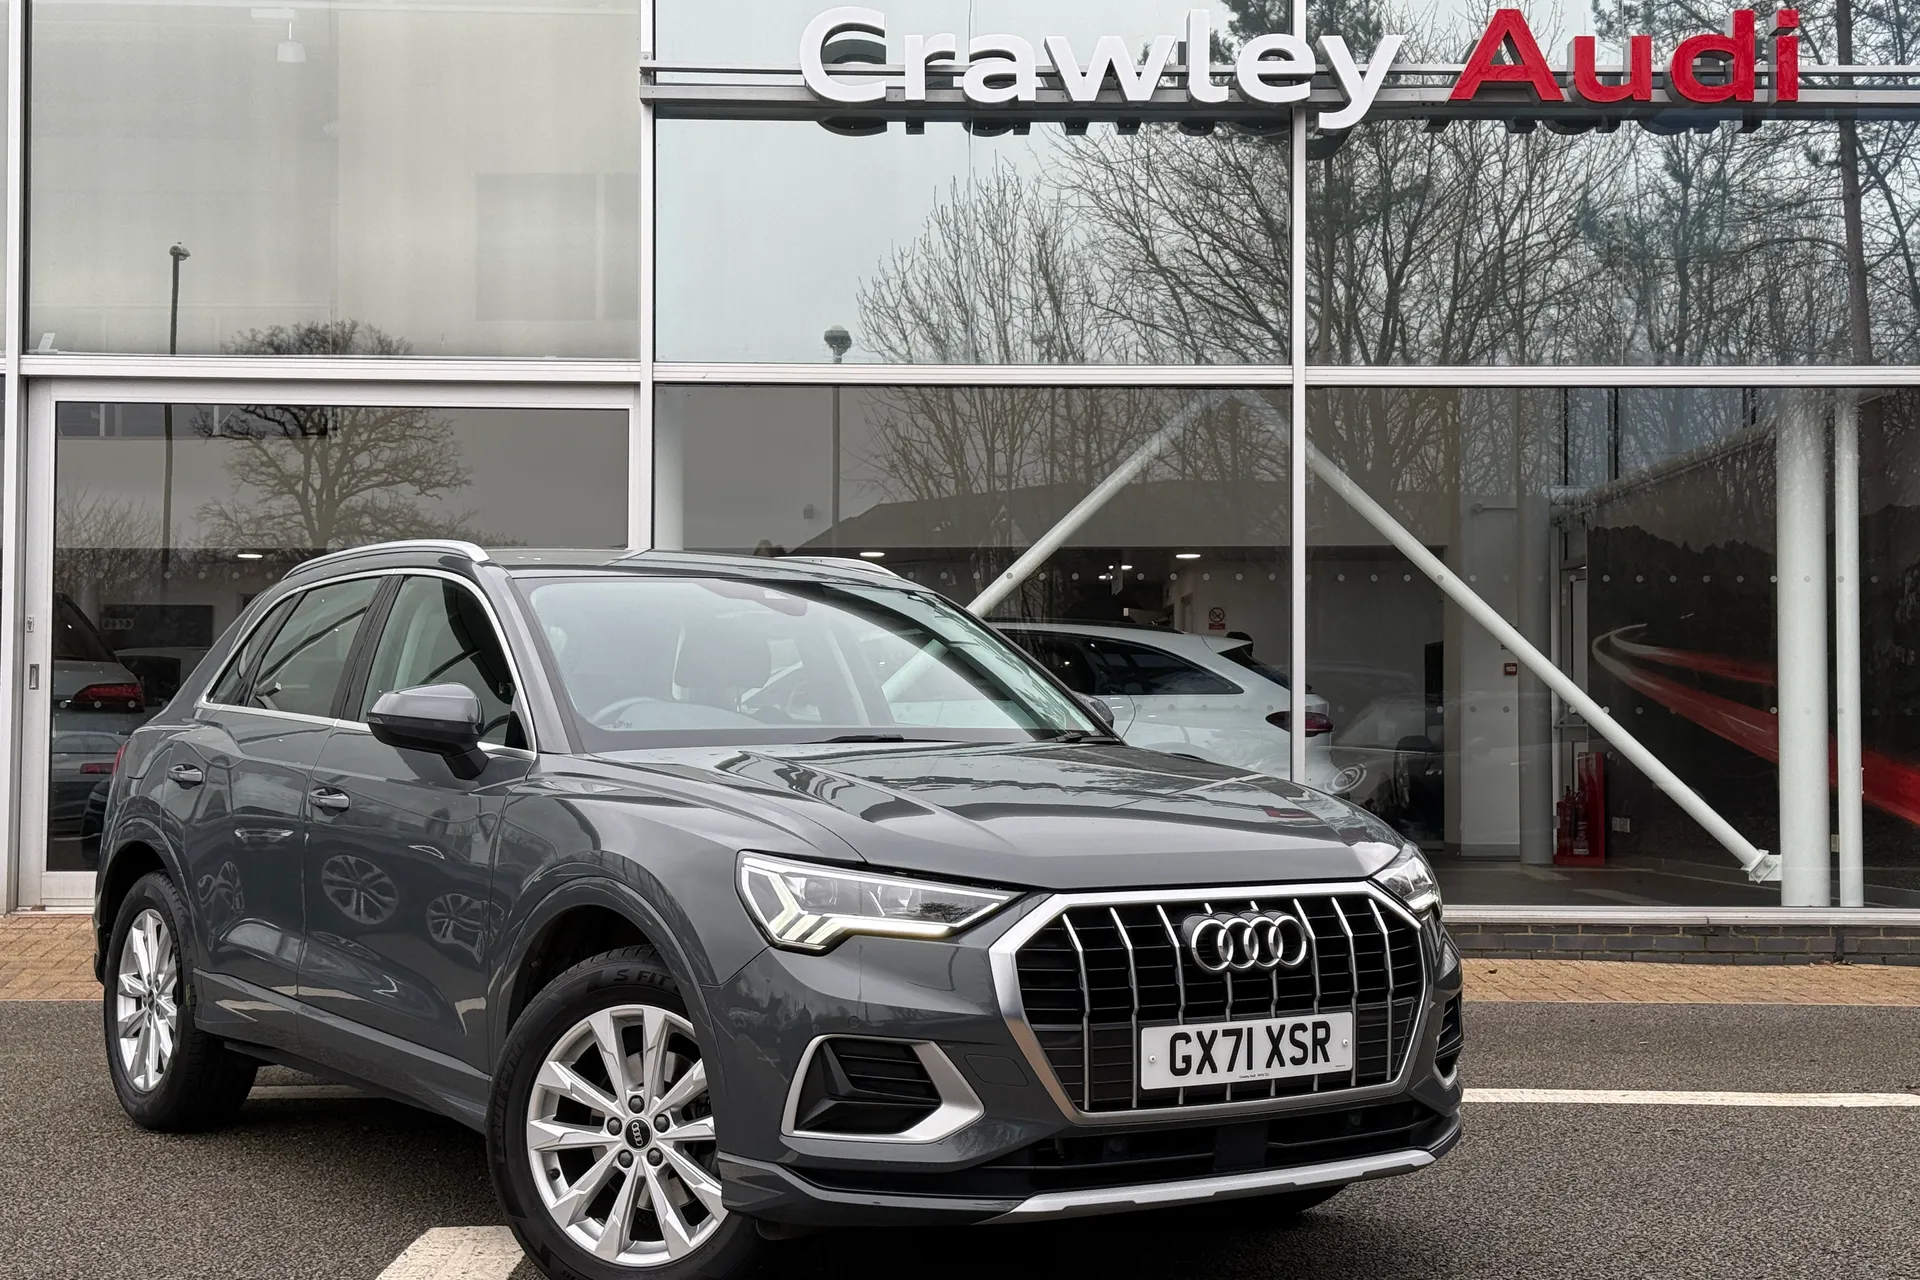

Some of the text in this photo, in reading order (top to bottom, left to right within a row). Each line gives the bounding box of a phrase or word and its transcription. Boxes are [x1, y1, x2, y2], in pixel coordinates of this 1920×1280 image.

[799, 6, 1799, 130] Crawley Audi
[636, 970, 672, 987] FIT
[1169, 1020, 1331, 1077] GX71 XSR
